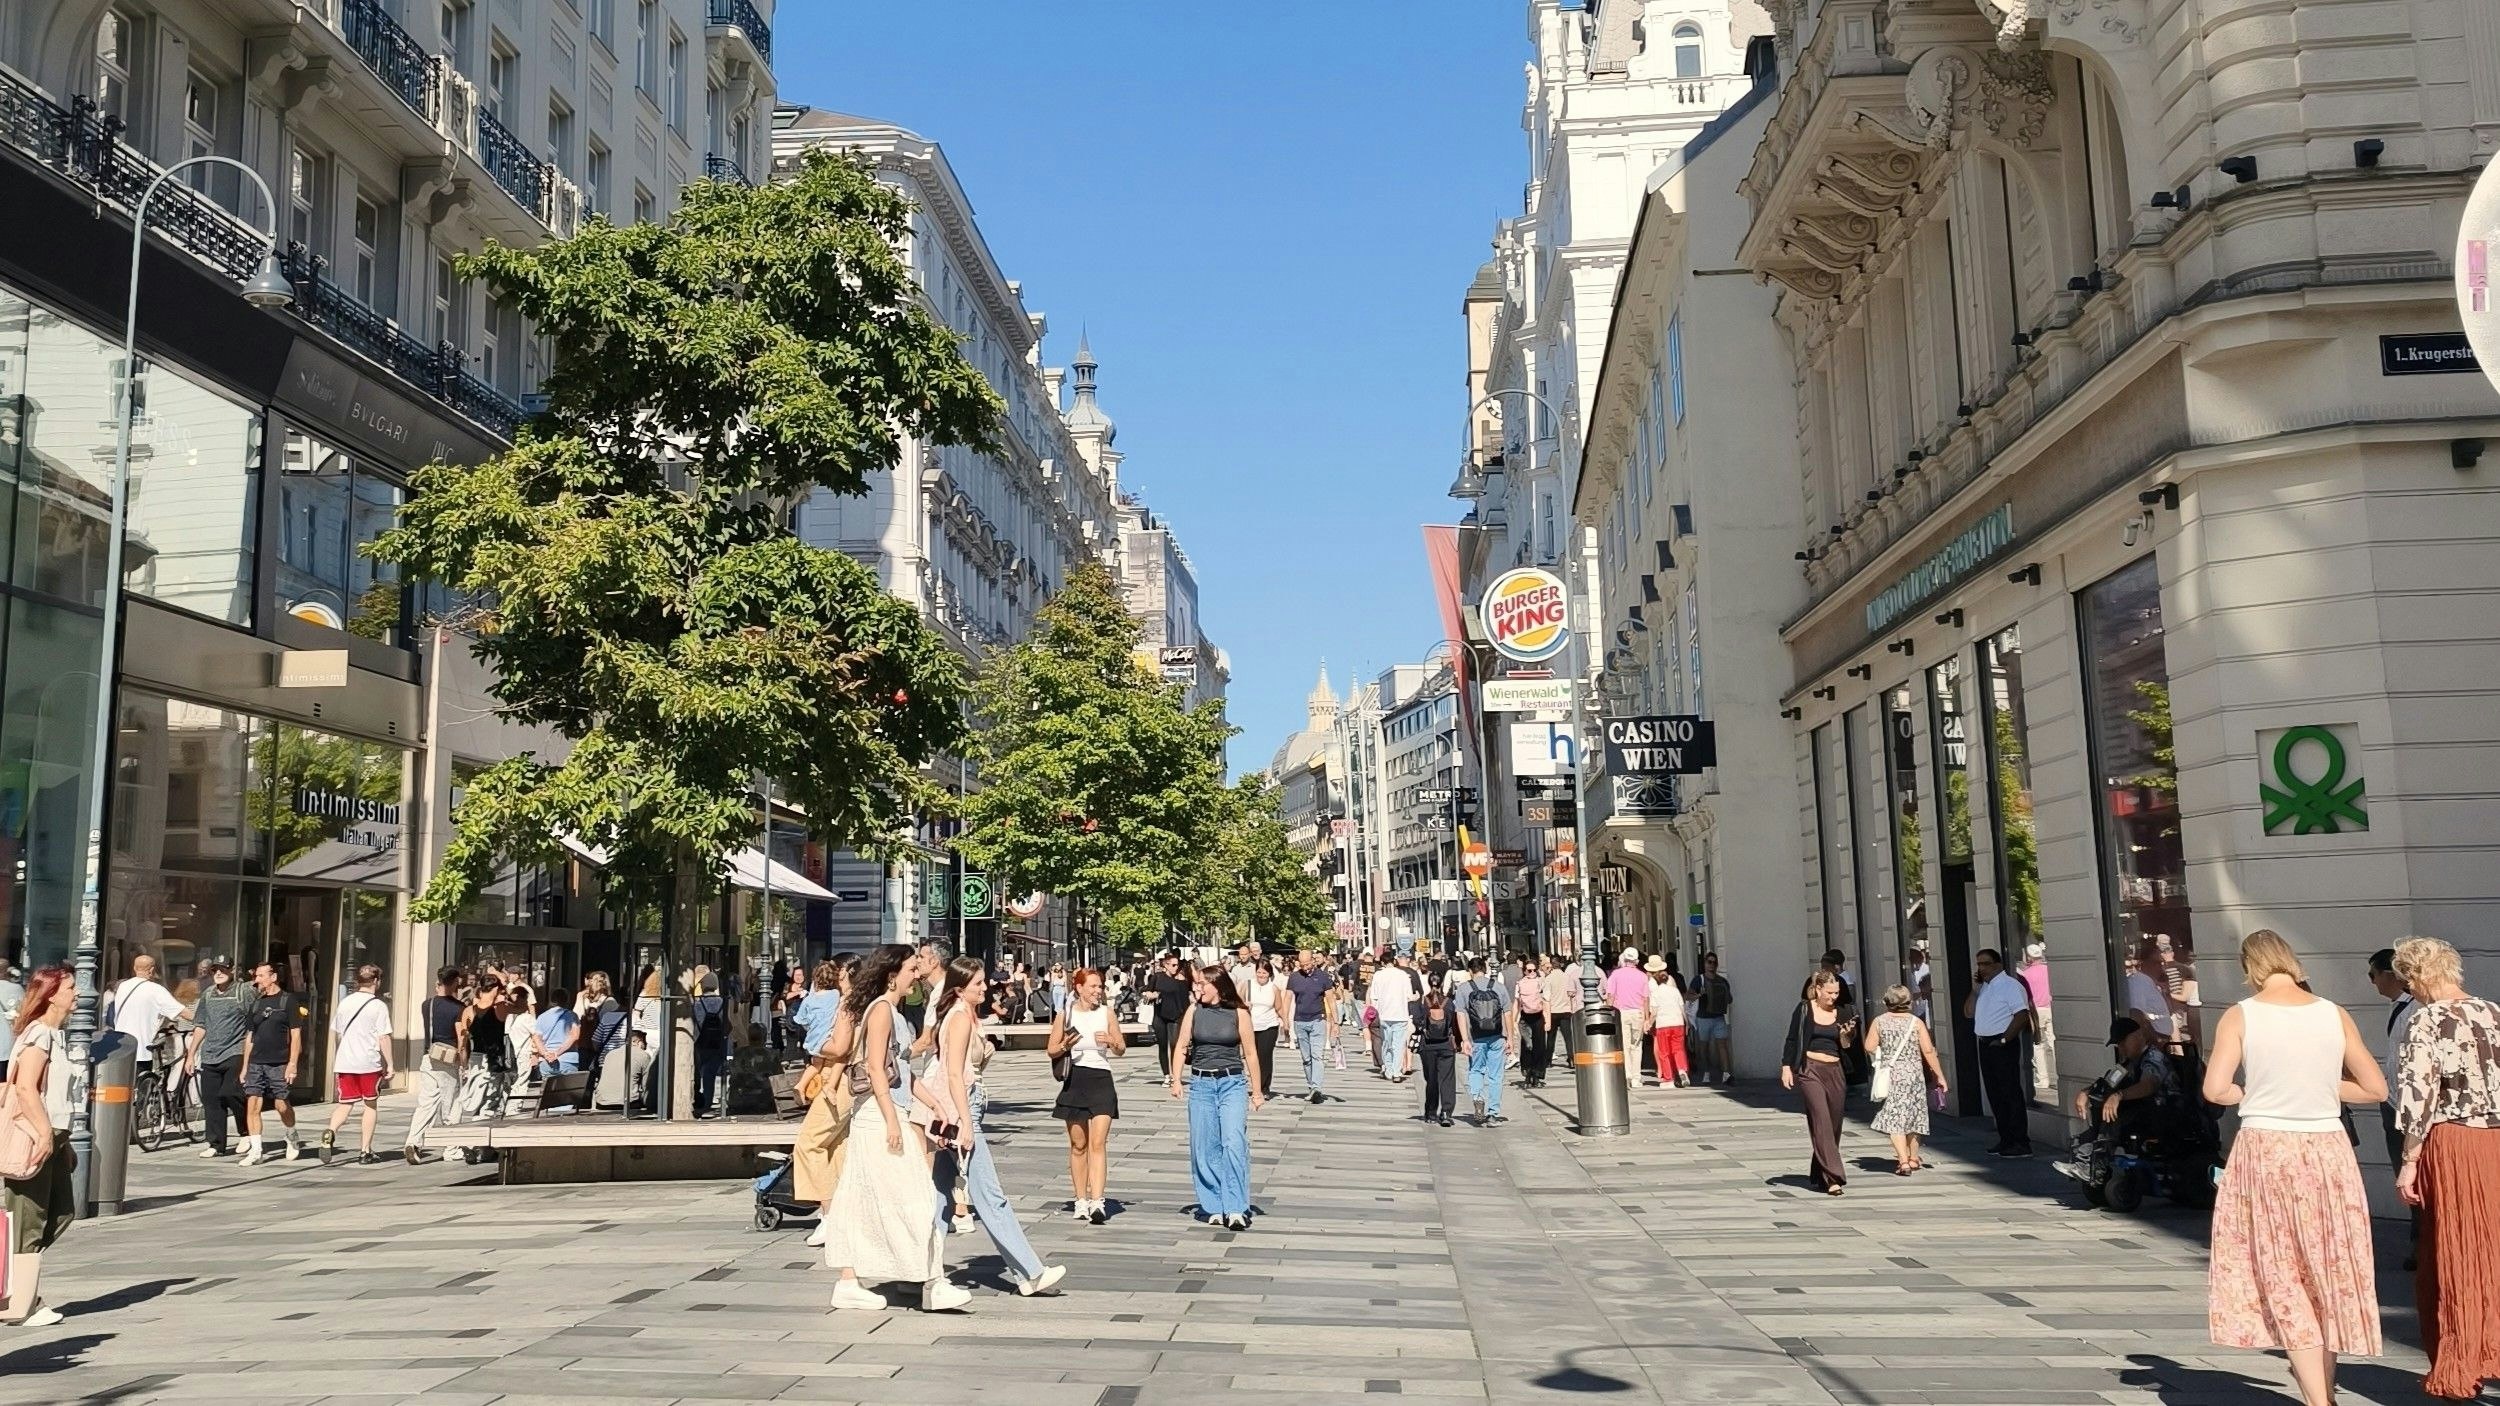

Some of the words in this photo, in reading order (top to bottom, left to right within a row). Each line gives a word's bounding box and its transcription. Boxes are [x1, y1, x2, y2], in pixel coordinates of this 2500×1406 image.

[2409, 346, 2475, 363] Krugerstr
[1493, 585, 1560, 619] BURGER
[1498, 600, 1565, 641] KING
[1489, 686, 1559, 699] Wienerwald
[1520, 699, 1572, 709] Restaurant
[1608, 720, 1694, 744] CASINO
[1621, 747, 1683, 771] WIEN
